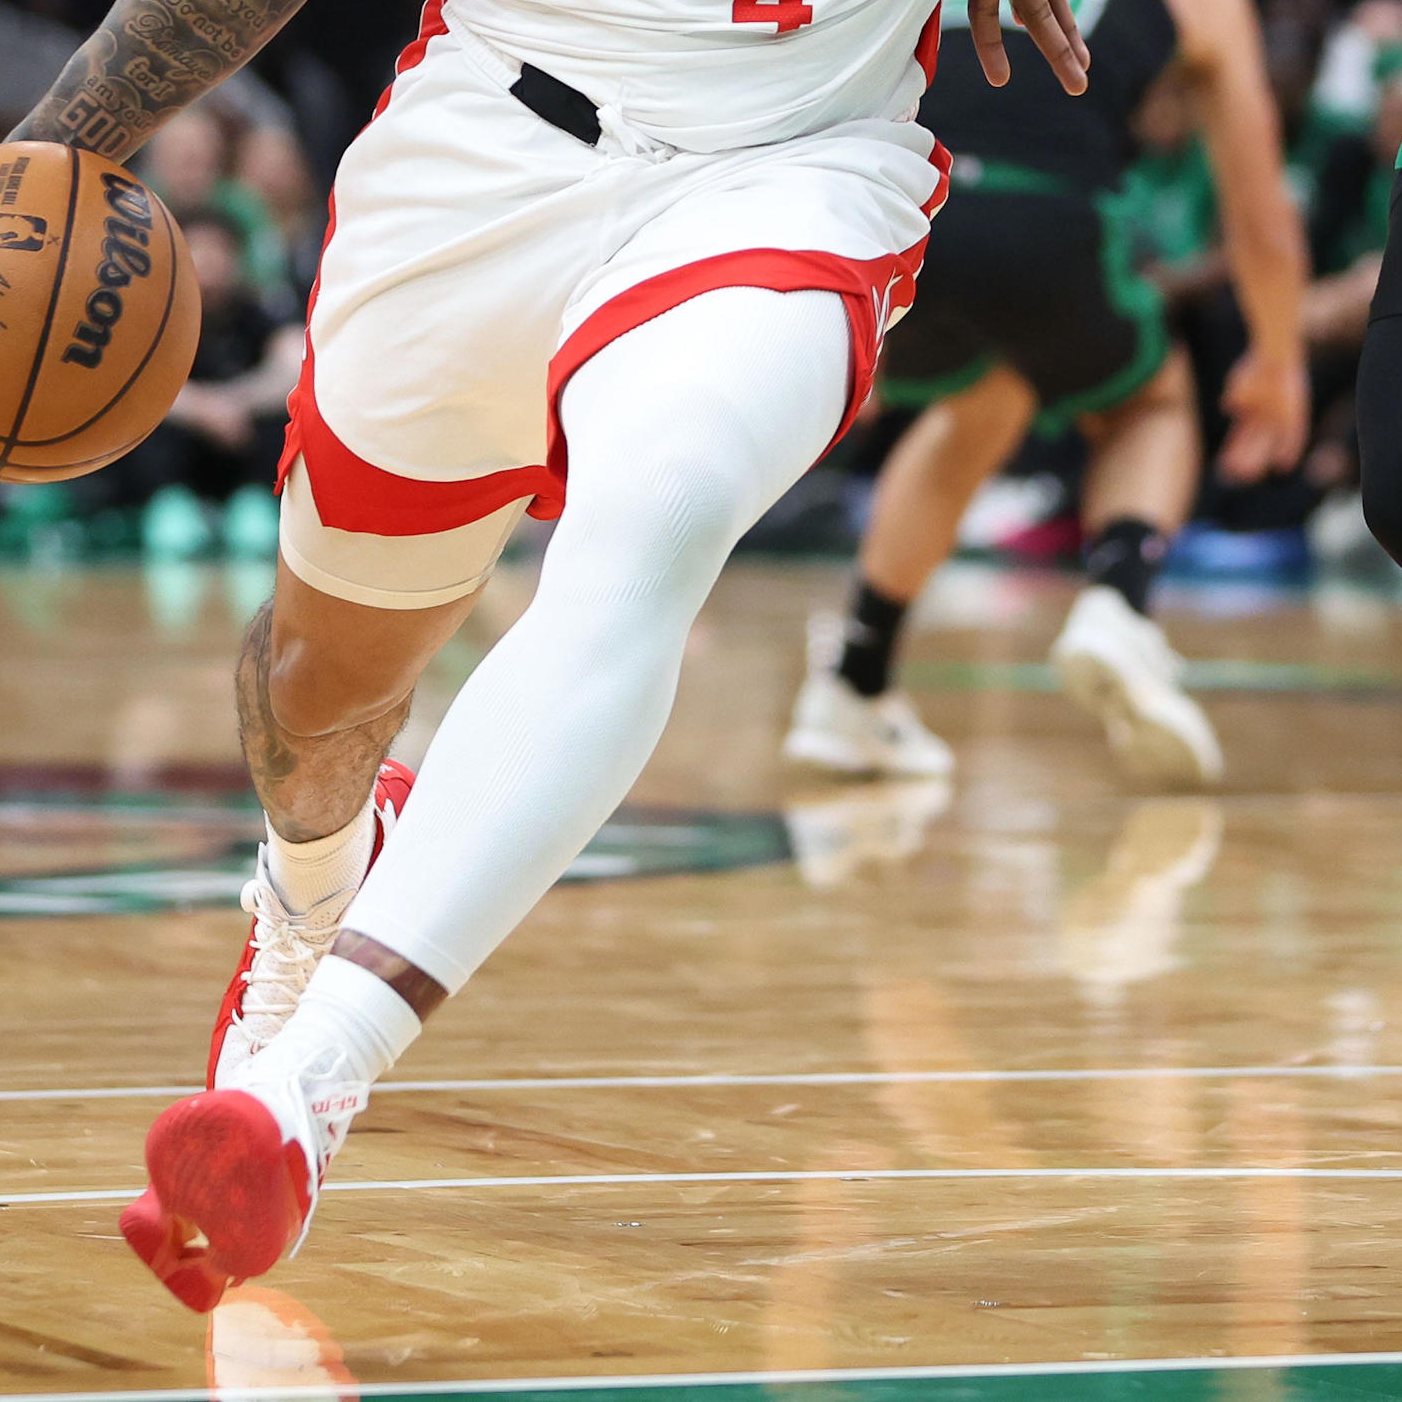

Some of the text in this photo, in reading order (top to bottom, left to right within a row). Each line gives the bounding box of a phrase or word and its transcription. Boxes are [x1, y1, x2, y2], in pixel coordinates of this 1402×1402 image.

[230, 0, 266, 29] you
[193, 15, 223, 43] not
[220, 35, 241, 59] be
[86, 77, 115, 101] am
[128, 61, 157, 87] for
[58, 90, 132, 158] GOD
[60, 171, 155, 370] Wilson
